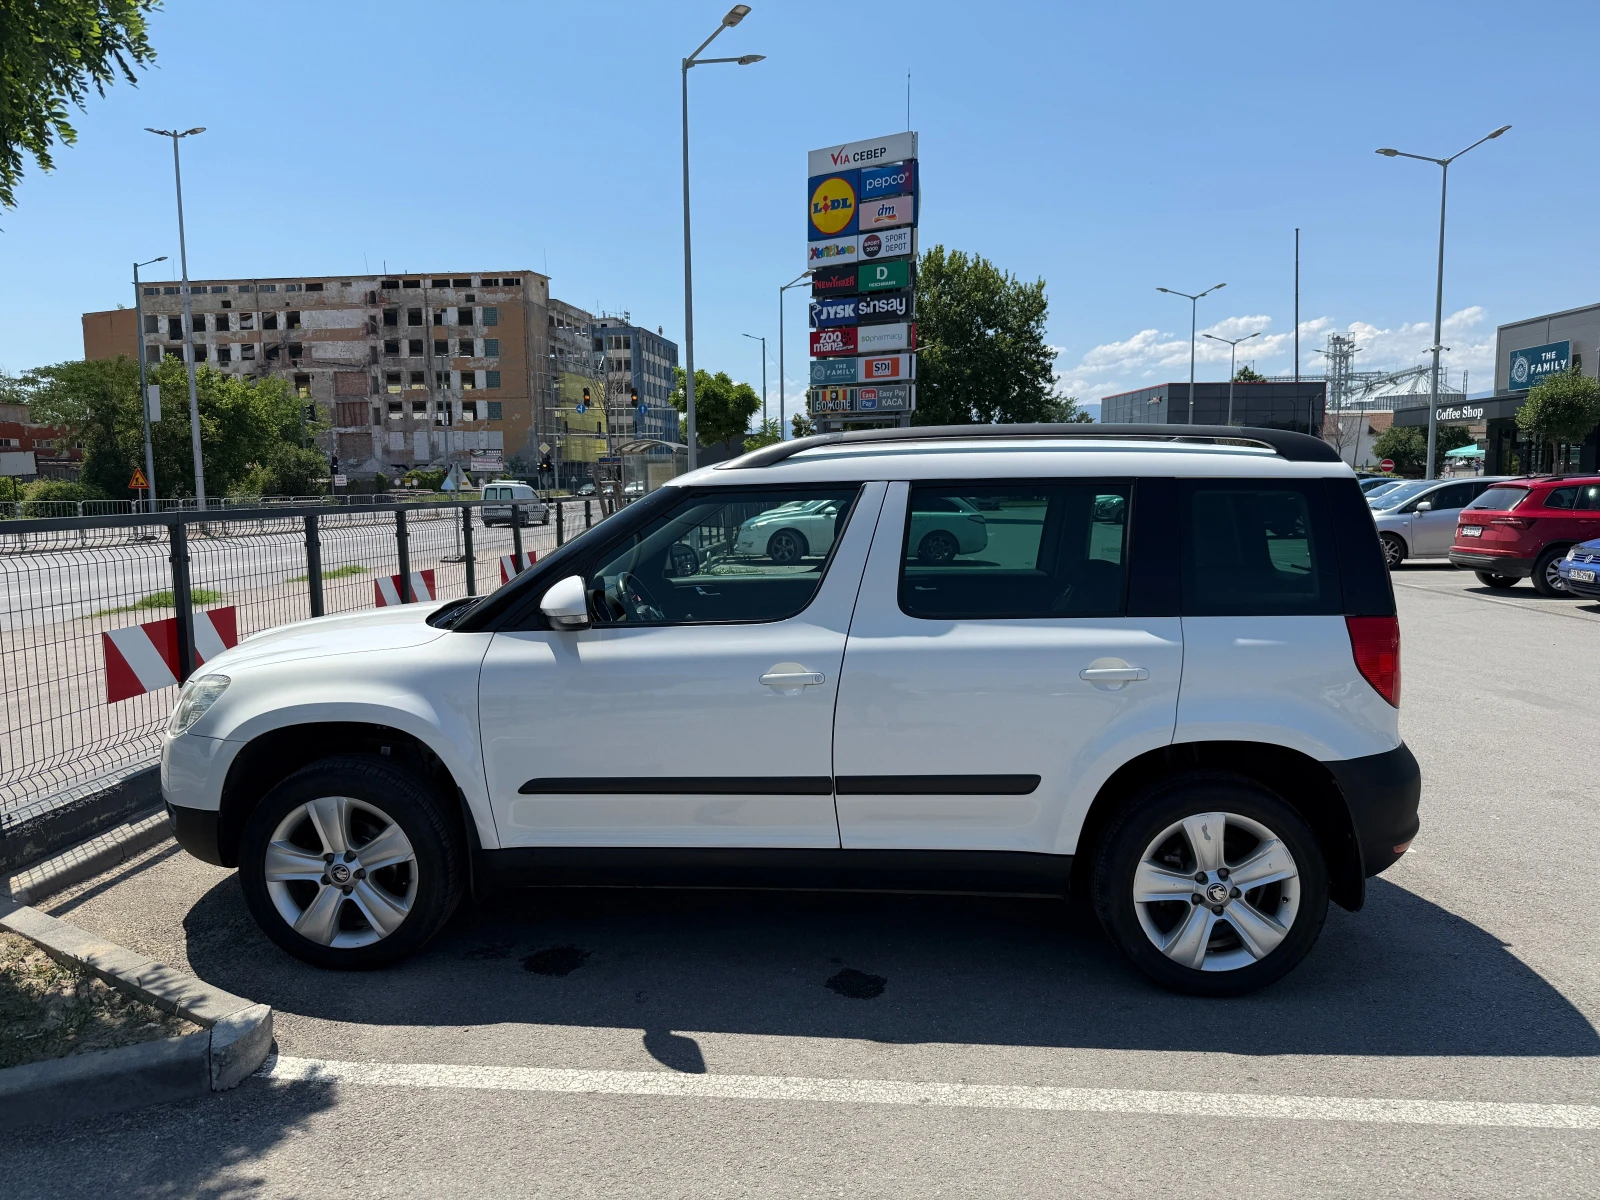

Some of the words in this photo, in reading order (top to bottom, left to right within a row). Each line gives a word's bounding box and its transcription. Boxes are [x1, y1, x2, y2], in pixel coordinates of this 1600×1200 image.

[830, 145, 851, 167] VIA
[866, 174, 906, 192] pepco
[812, 195, 852, 214] LIDL
[877, 203, 895, 216] dm
[885, 233, 907, 243] SPORT
[885, 242, 907, 252] DEPOT
[876, 266, 888, 280] D
[820, 304, 856, 320] JYSK
[858, 297, 906, 315] sinsay
[861, 333, 903, 342] sopharmacy
[813, 342, 843, 352] mania
[1541, 351, 1557, 360] THE
[827, 368, 855, 376] FAMILY
[874, 362, 890, 372] SDI
[1530, 359, 1568, 374] FAMILY
[894, 389, 906, 397] Pay
[816, 400, 851, 411] БОЖОЛЕ
[1436, 407, 1461, 421] Coffee
[1462, 405, 1483, 420] Shop
